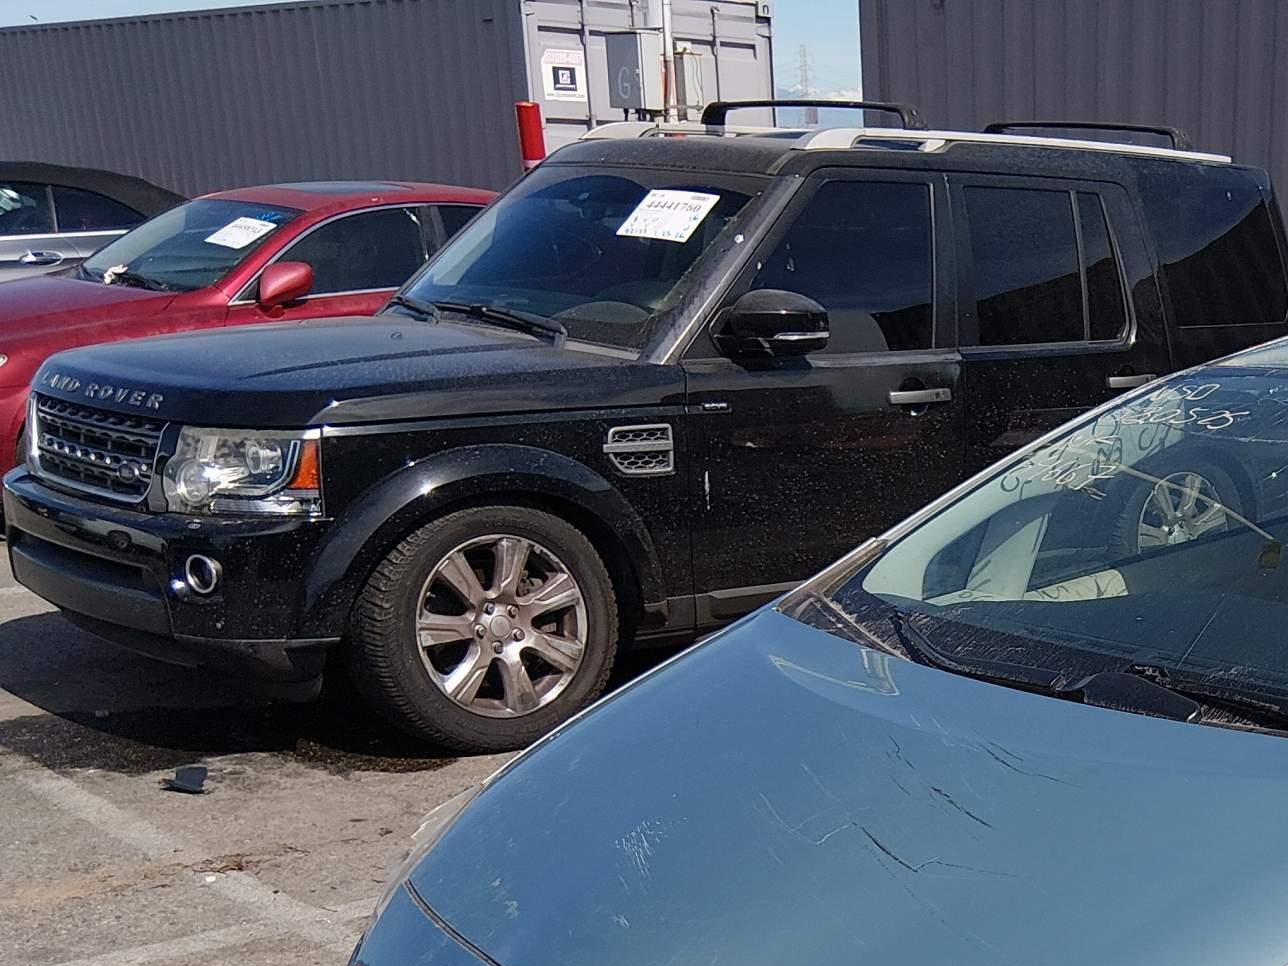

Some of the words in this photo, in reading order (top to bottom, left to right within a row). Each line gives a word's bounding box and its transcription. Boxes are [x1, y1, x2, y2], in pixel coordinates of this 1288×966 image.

[617, 66, 631, 100] G
[41, 370, 81, 393] LAND
[85, 383, 165, 411] ROVER
